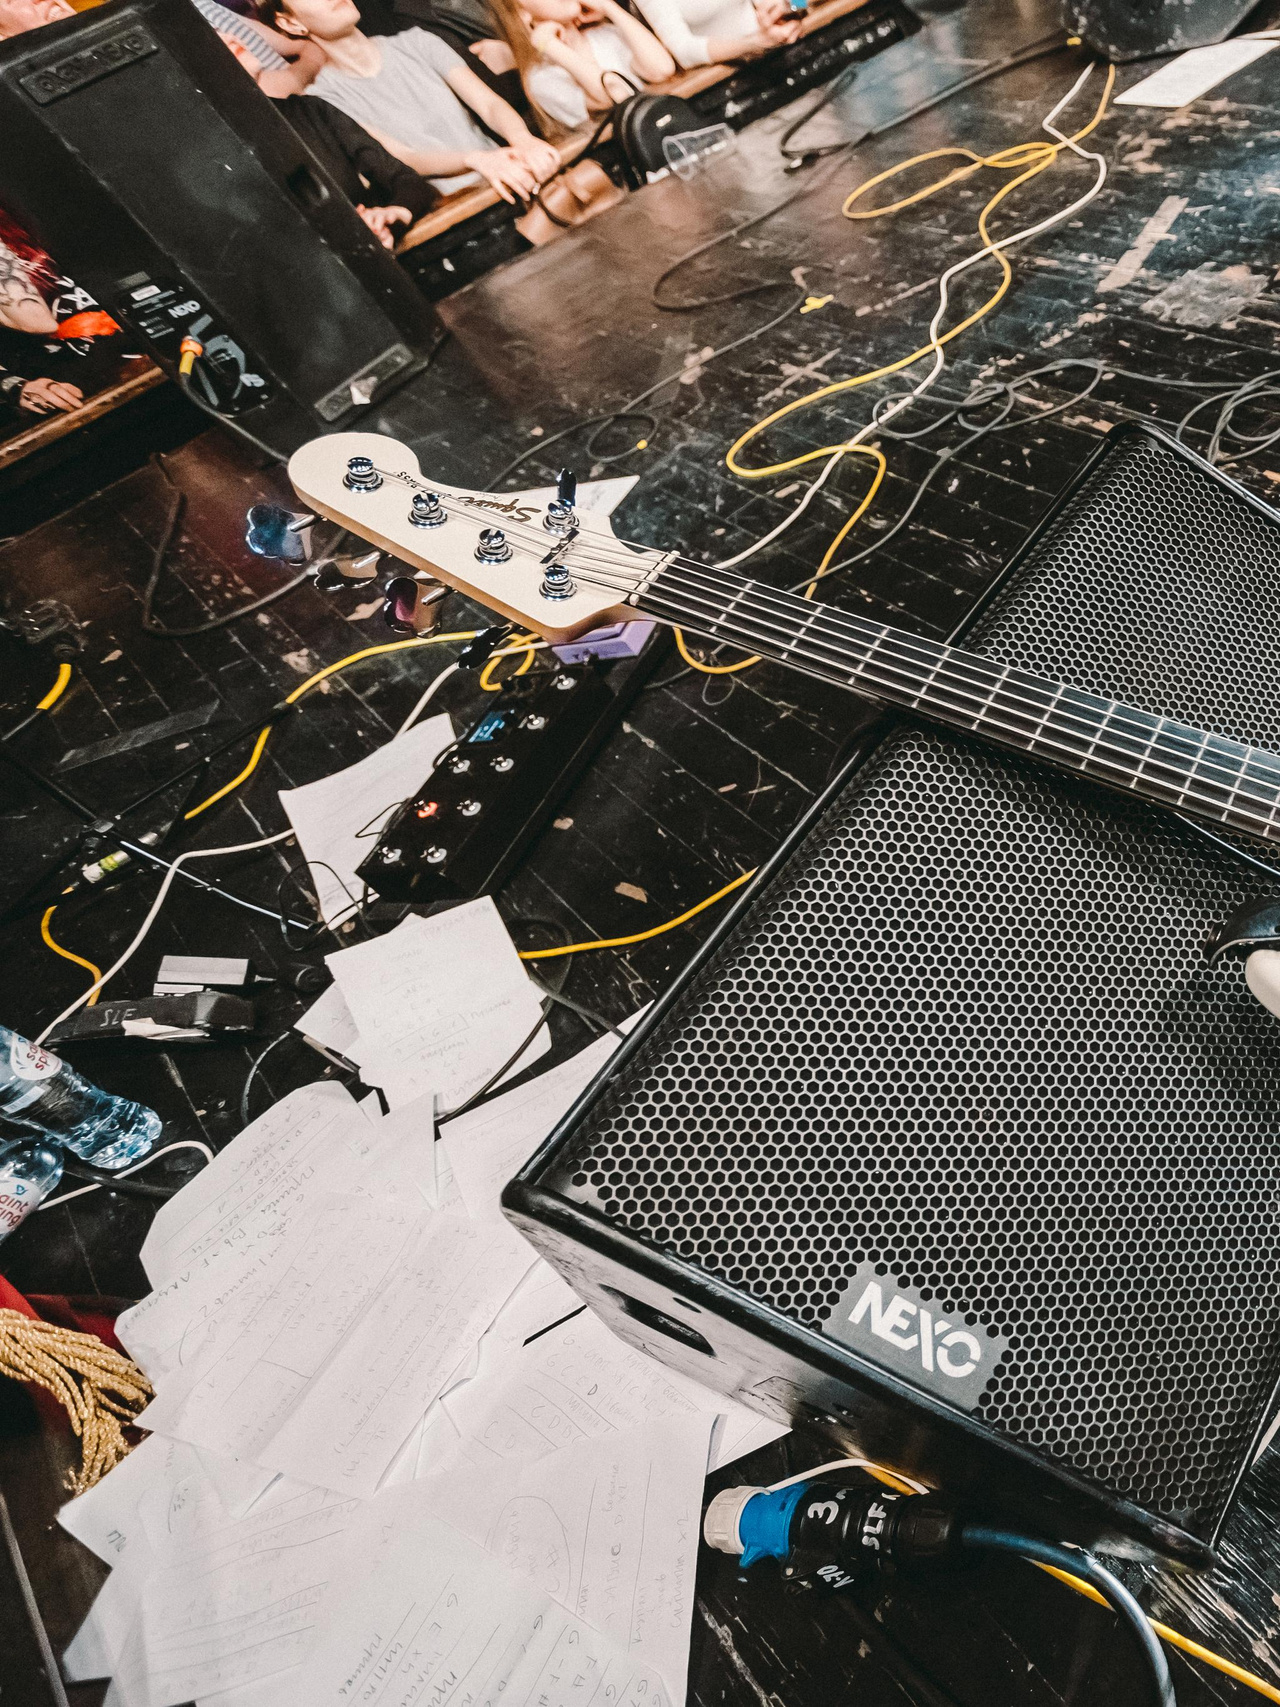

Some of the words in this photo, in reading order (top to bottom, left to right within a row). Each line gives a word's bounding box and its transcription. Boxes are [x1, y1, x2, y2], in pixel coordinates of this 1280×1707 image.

[0, 1194, 28, 1213] aint
[0, 1208, 22, 1227] ing
[848, 1281, 981, 1378] NEXO
